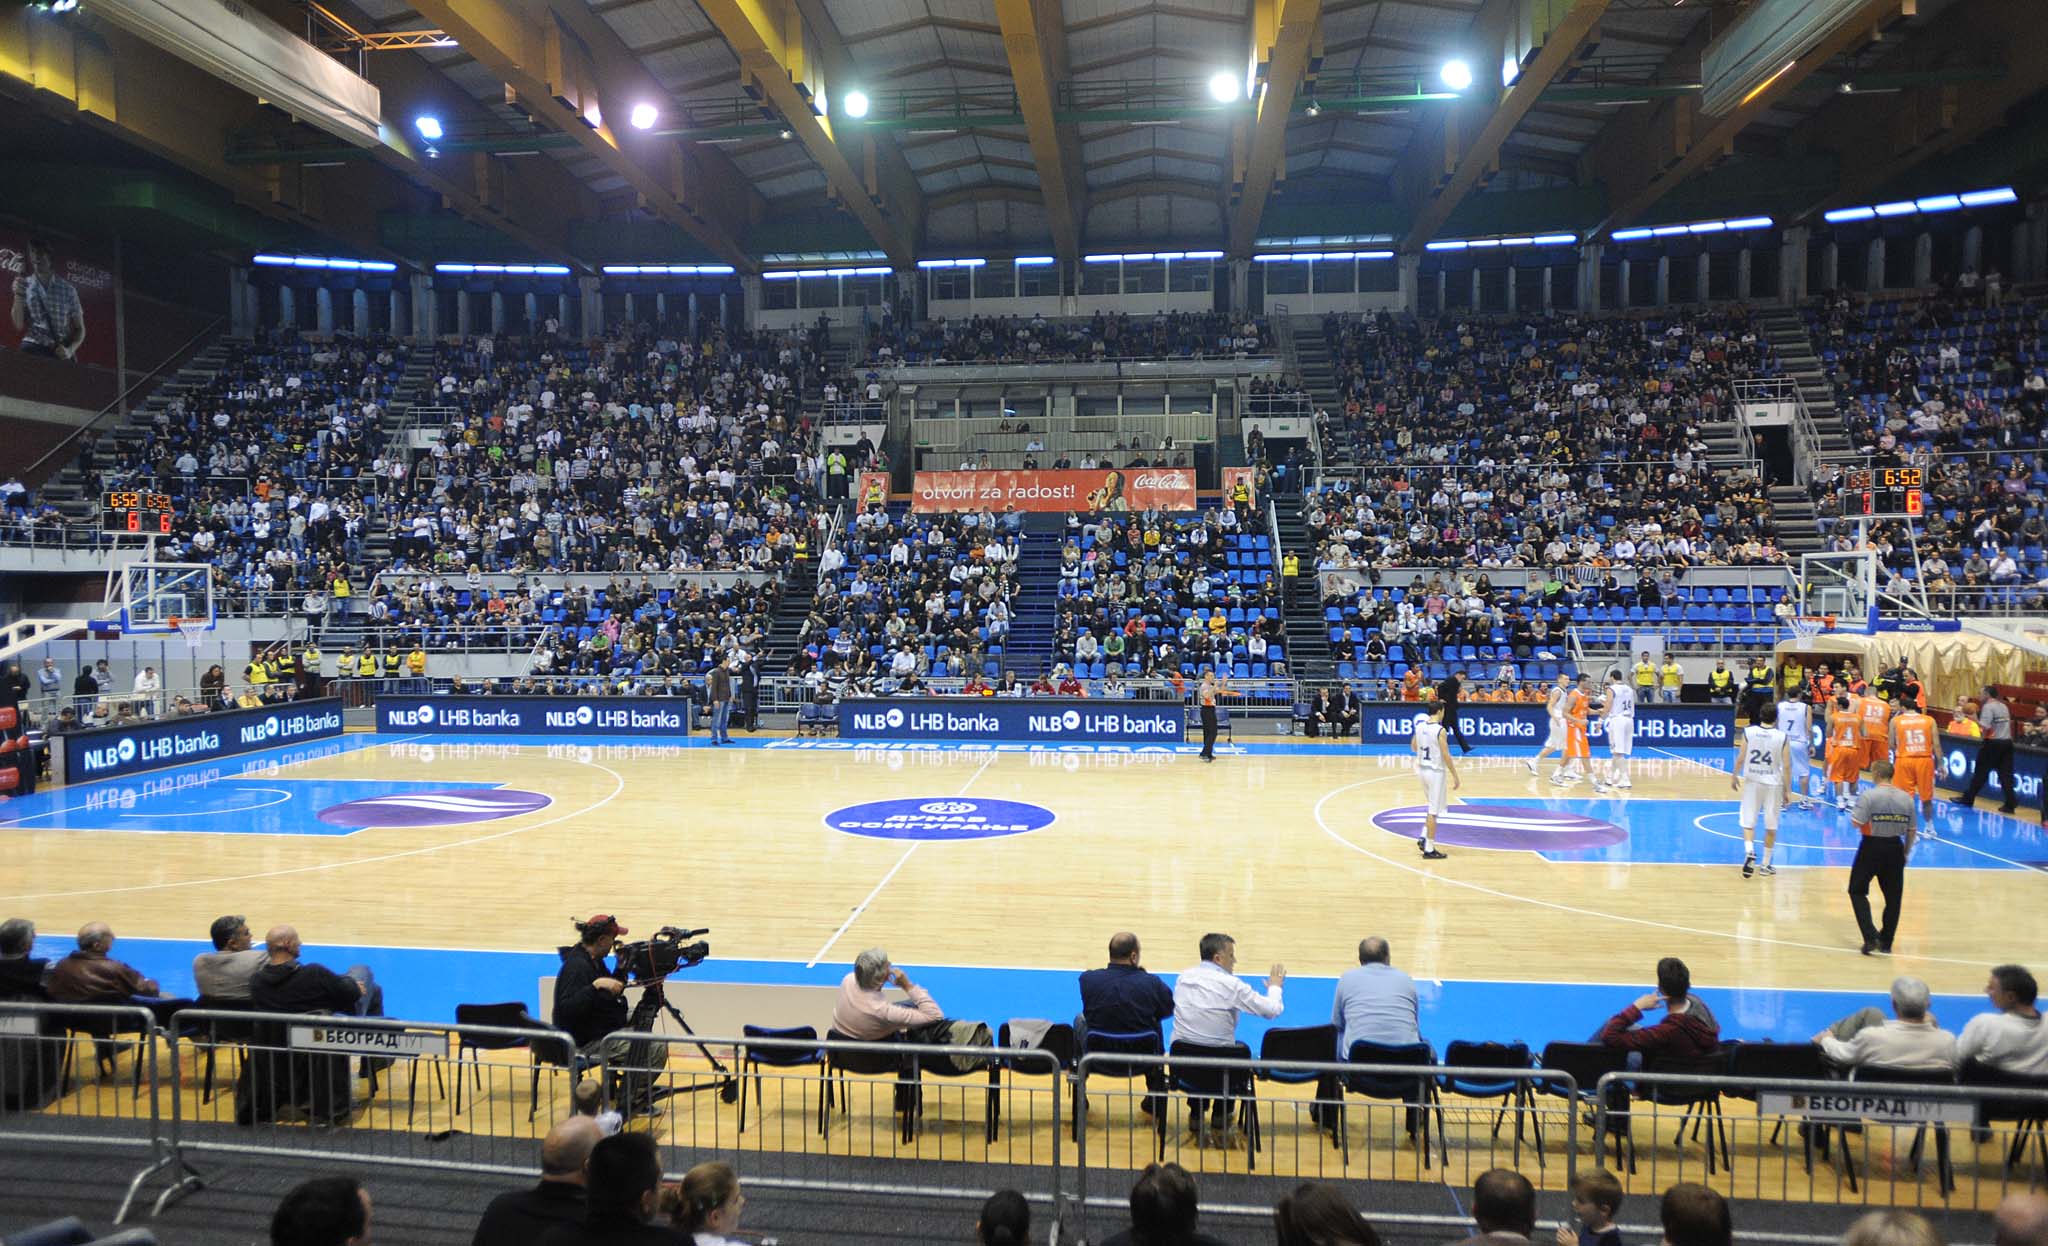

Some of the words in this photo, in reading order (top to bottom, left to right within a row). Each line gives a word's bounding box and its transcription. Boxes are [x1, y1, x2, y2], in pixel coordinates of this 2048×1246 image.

[1885, 468, 1921, 485] 6:52
[111, 493, 138, 507] 6:52
[147, 494, 170, 508] 6:52
[922, 486, 974, 500] otvori
[980, 488, 1001, 499] za
[1007, 484, 1075, 499] radost!
[1906, 490, 1922, 514] 6
[128, 511, 139, 532] 6
[161, 513, 170, 533] 6
[389, 711, 419, 726] NLB
[439, 710, 469, 726] LHB
[473, 709, 520, 727] banka
[546, 711, 576, 727] NLB
[597, 711, 628, 727] LHB
[631, 710, 680, 728] banka
[854, 714, 886, 729] NLB
[911, 713, 944, 730] LHB
[947, 712, 999, 732] banka
[1029, 715, 1062, 731] NLB
[1085, 715, 1119, 733] LHB
[1123, 714, 1176, 734] banka
[1378, 719, 1412, 735] NLB
[1480, 717, 1535, 736] banka
[1786, 719, 1795, 731] 7
[241, 724, 266, 743] NLB
[281, 716, 304, 736] LHB
[306, 712, 339, 732] banka
[1669, 718, 1726, 738] banka
[1904, 729, 1925, 744] 15
[84, 746, 118, 771] NLB
[141, 737, 172, 760] LHB
[174, 730, 220, 755] banka
[1749, 749, 1773, 766] 24
[884, 815, 987, 823] ДУНАВ
